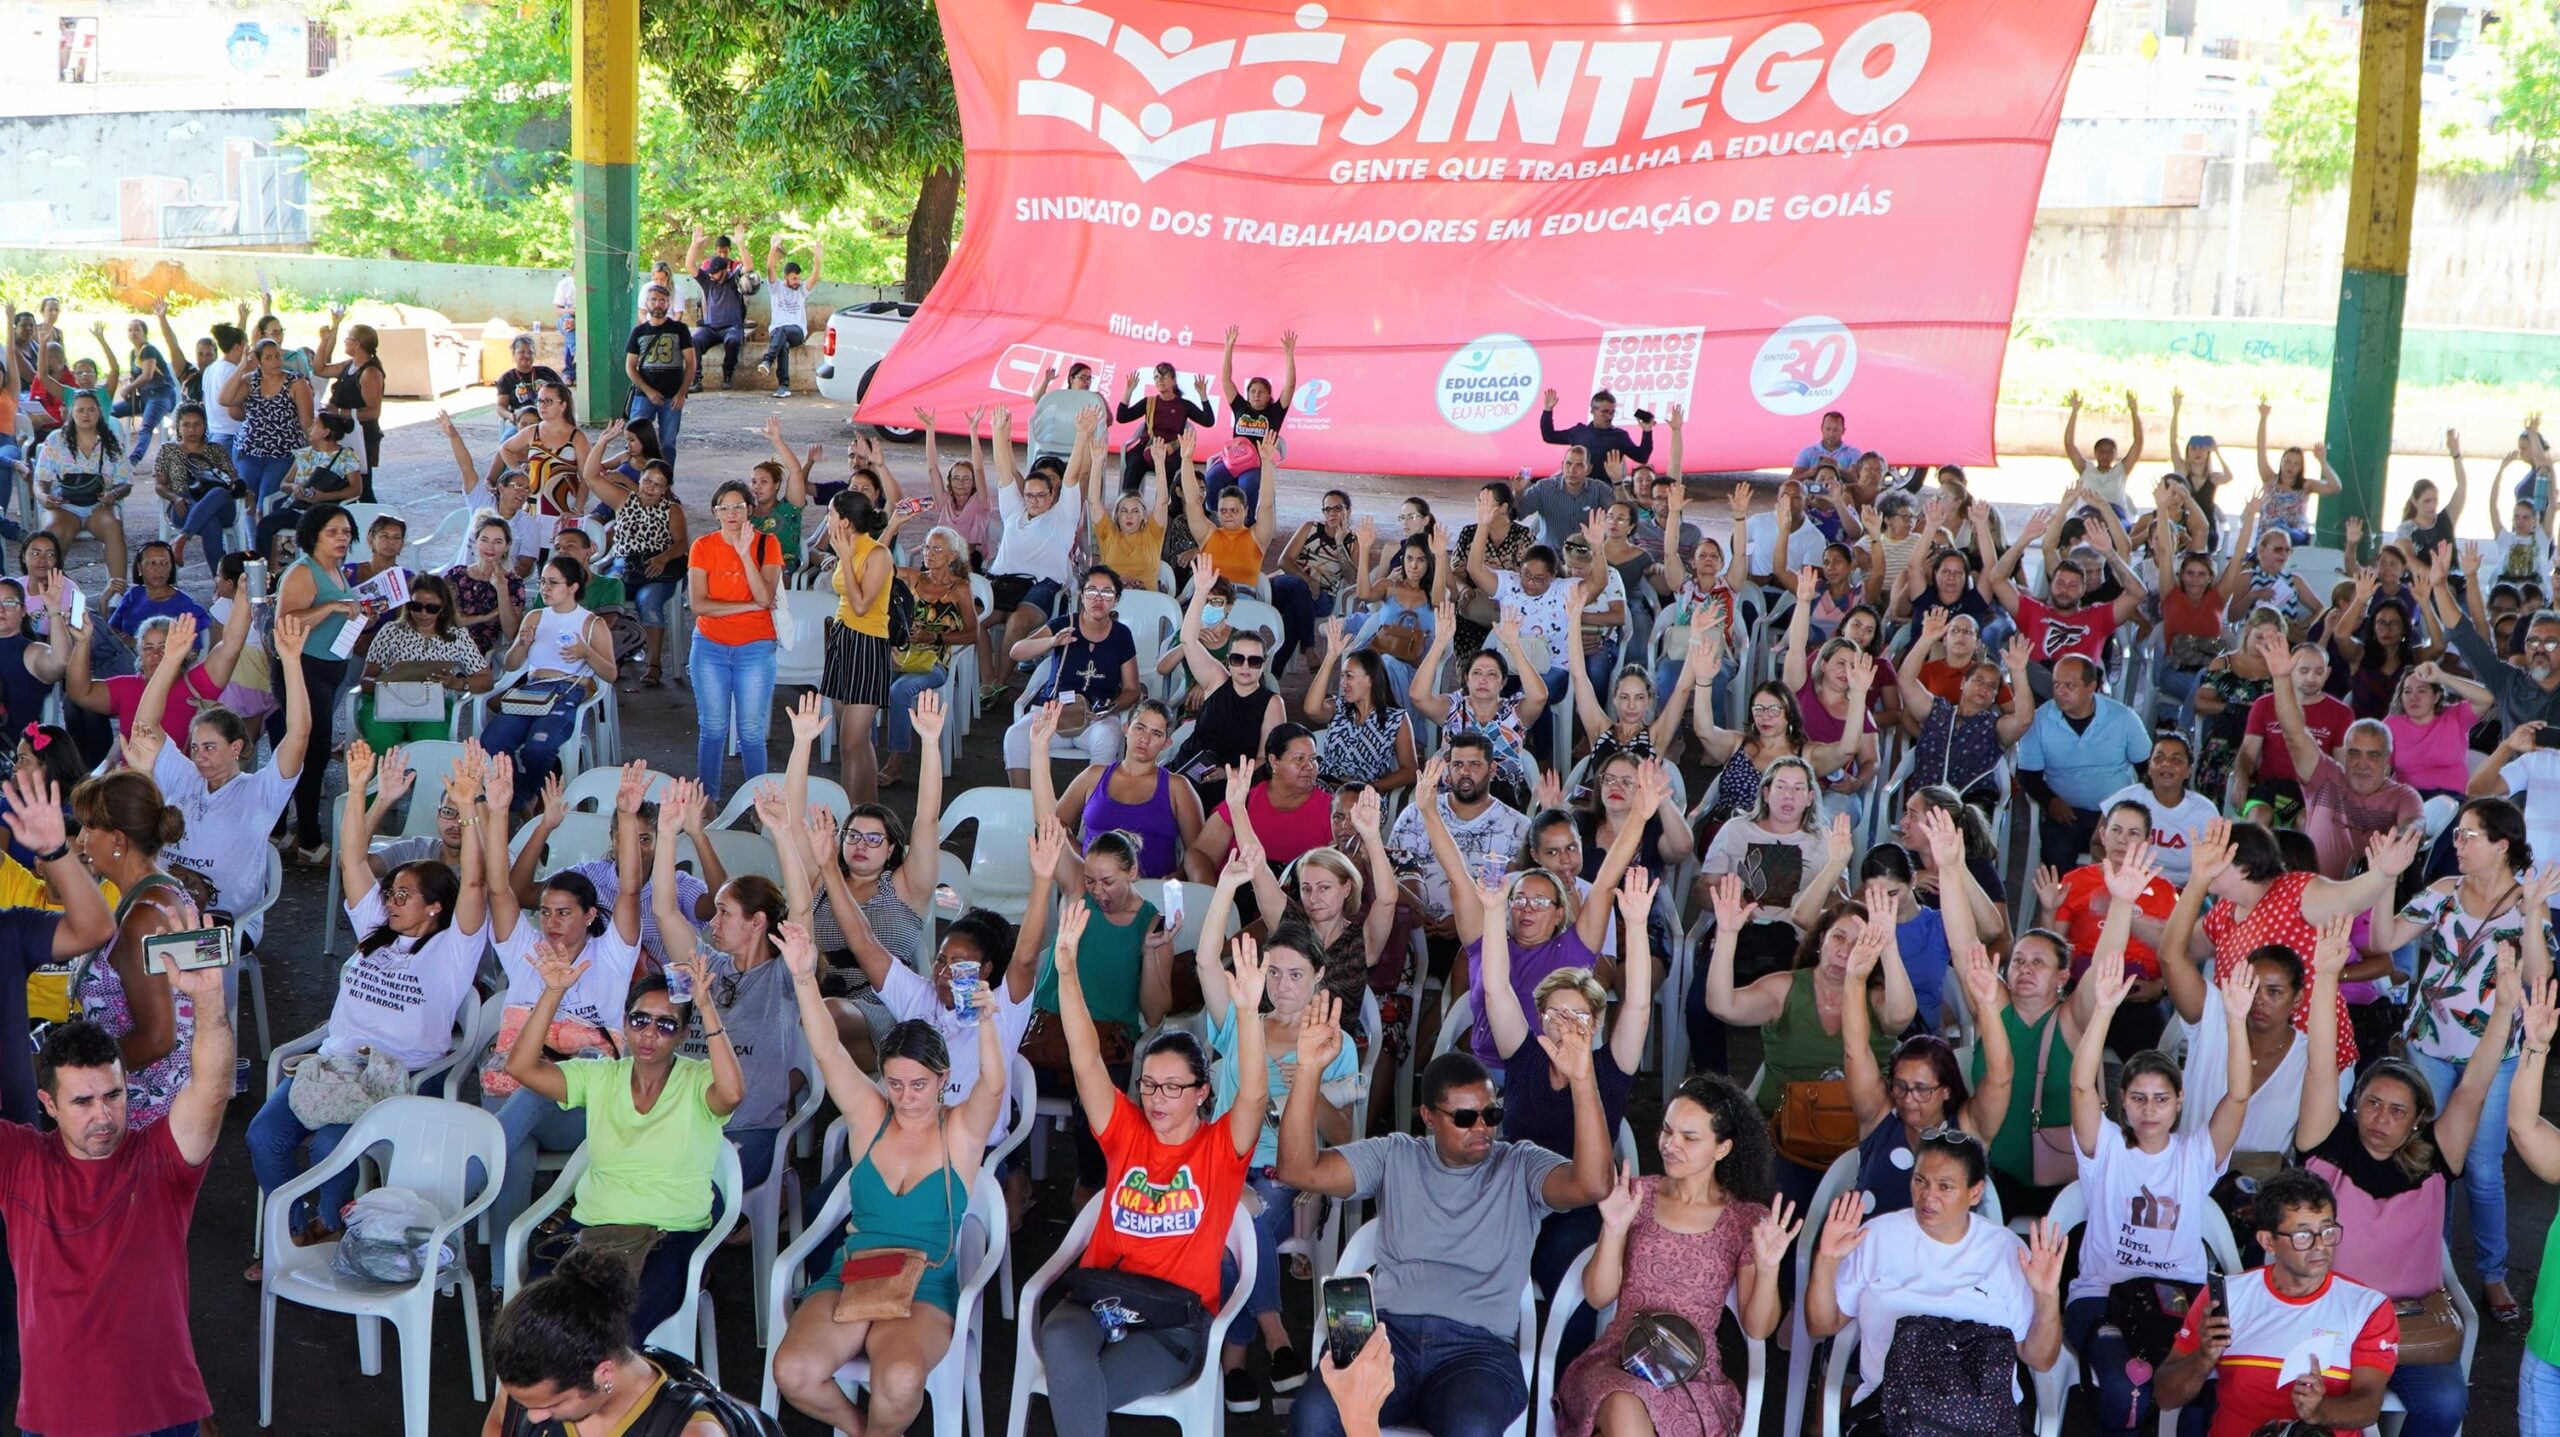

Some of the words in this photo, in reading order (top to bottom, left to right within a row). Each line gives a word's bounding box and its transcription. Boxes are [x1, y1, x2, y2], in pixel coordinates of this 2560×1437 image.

[1339, 11, 1931, 147] SINTEGO
[1329, 157, 1430, 184] GENTE
[1438, 157, 1508, 182] QUE
[1518, 145, 1681, 182] TRABALHA
[1690, 140, 1714, 162] A
[1725, 120, 1909, 160] EDUCAÇÃO
[1015, 196, 1141, 228] SINDICATO
[1149, 206, 1212, 238] DOS
[1222, 216, 1479, 248] TRABALHADORES
[1486, 218, 1533, 241] EM
[1540, 194, 1721, 237] EDUCAÇÃO
[1730, 197, 1775, 223] DE
[1784, 184, 1893, 221] GOIÁS
[1108, 313, 1172, 344] filiado
[1177, 325, 1193, 347] à
[1605, 332, 1698, 355] SOMOS
[1602, 352, 1694, 374] FORTES
[1763, 352, 1797, 362] SINTEGO
[1780, 334, 1846, 388] 30
[1445, 372, 1532, 390] EDUCAÇÃO
[1599, 371, 1690, 392] SOMOS
[1451, 390, 1520, 404] PÚBLICA
[1806, 389, 1834, 397] ANOS
[1451, 406, 1472, 420] EU
[1474, 402, 1518, 419] APOIO
[2151, 828, 2187, 849] ILA
[359, 970, 379, 983] SEUS
[397, 973, 419, 983] LUTA
[360, 982, 387, 997] DIGNO
[349, 989, 364, 1000] RUI
[365, 994, 404, 1012] BARBOSA
[574, 1004, 597, 1016] LUTA
[1120, 1188, 1142, 1211] NA
[1120, 1210, 1191, 1233] SEMPRE!
